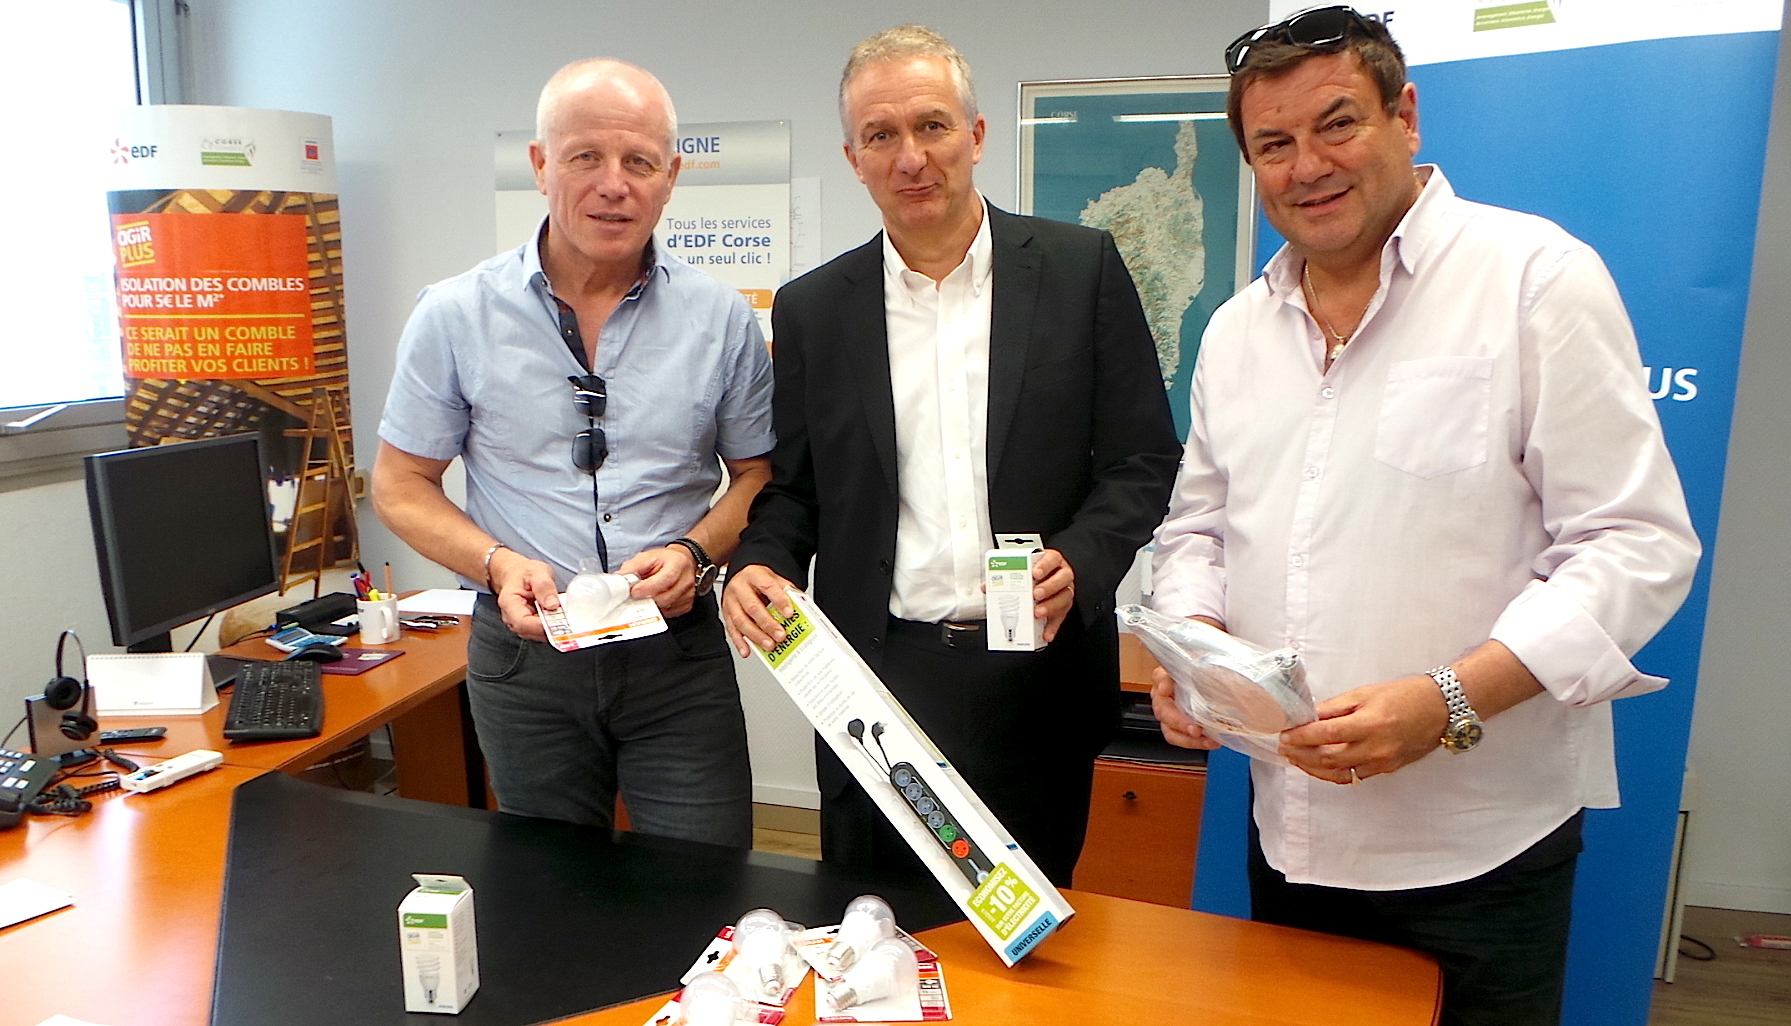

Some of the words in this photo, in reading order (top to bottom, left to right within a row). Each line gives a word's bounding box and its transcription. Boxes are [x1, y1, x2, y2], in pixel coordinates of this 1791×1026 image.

[666, 218, 697, 231] Tous
[701, 216, 718, 230] les
[721, 216, 771, 229] services
[722, 233, 771, 248] Corse
[119, 241, 155, 263] PLUS
[687, 255, 704, 264] un
[709, 251, 736, 264] seul
[740, 251, 762, 264] clic
[767, 252, 771, 264] !
[120, 277, 187, 291] ISOLATION
[190, 277, 223, 291] DES
[226, 277, 305, 291] COMBLES
[122, 294, 154, 308] POUR
[155, 294, 174, 307] 5€
[175, 294, 194, 308] LE
[126, 326, 139, 340] CE
[140, 326, 189, 340] SERAIT
[193, 326, 220, 340] UN
[224, 325, 296, 340] COMBLE
[127, 342, 141, 356] DE
[143, 342, 160, 356] NE
[164, 342, 193, 356] PAS
[197, 343, 220, 356] EN
[226, 342, 273, 356] FAIRE
[128, 358, 188, 373] PROFITER
[190, 358, 227, 373] VOS
[232, 357, 299, 372] CLIENTS
[303, 356, 309, 370] !
[1010, 918, 1051, 956] UNIVERSELLE
